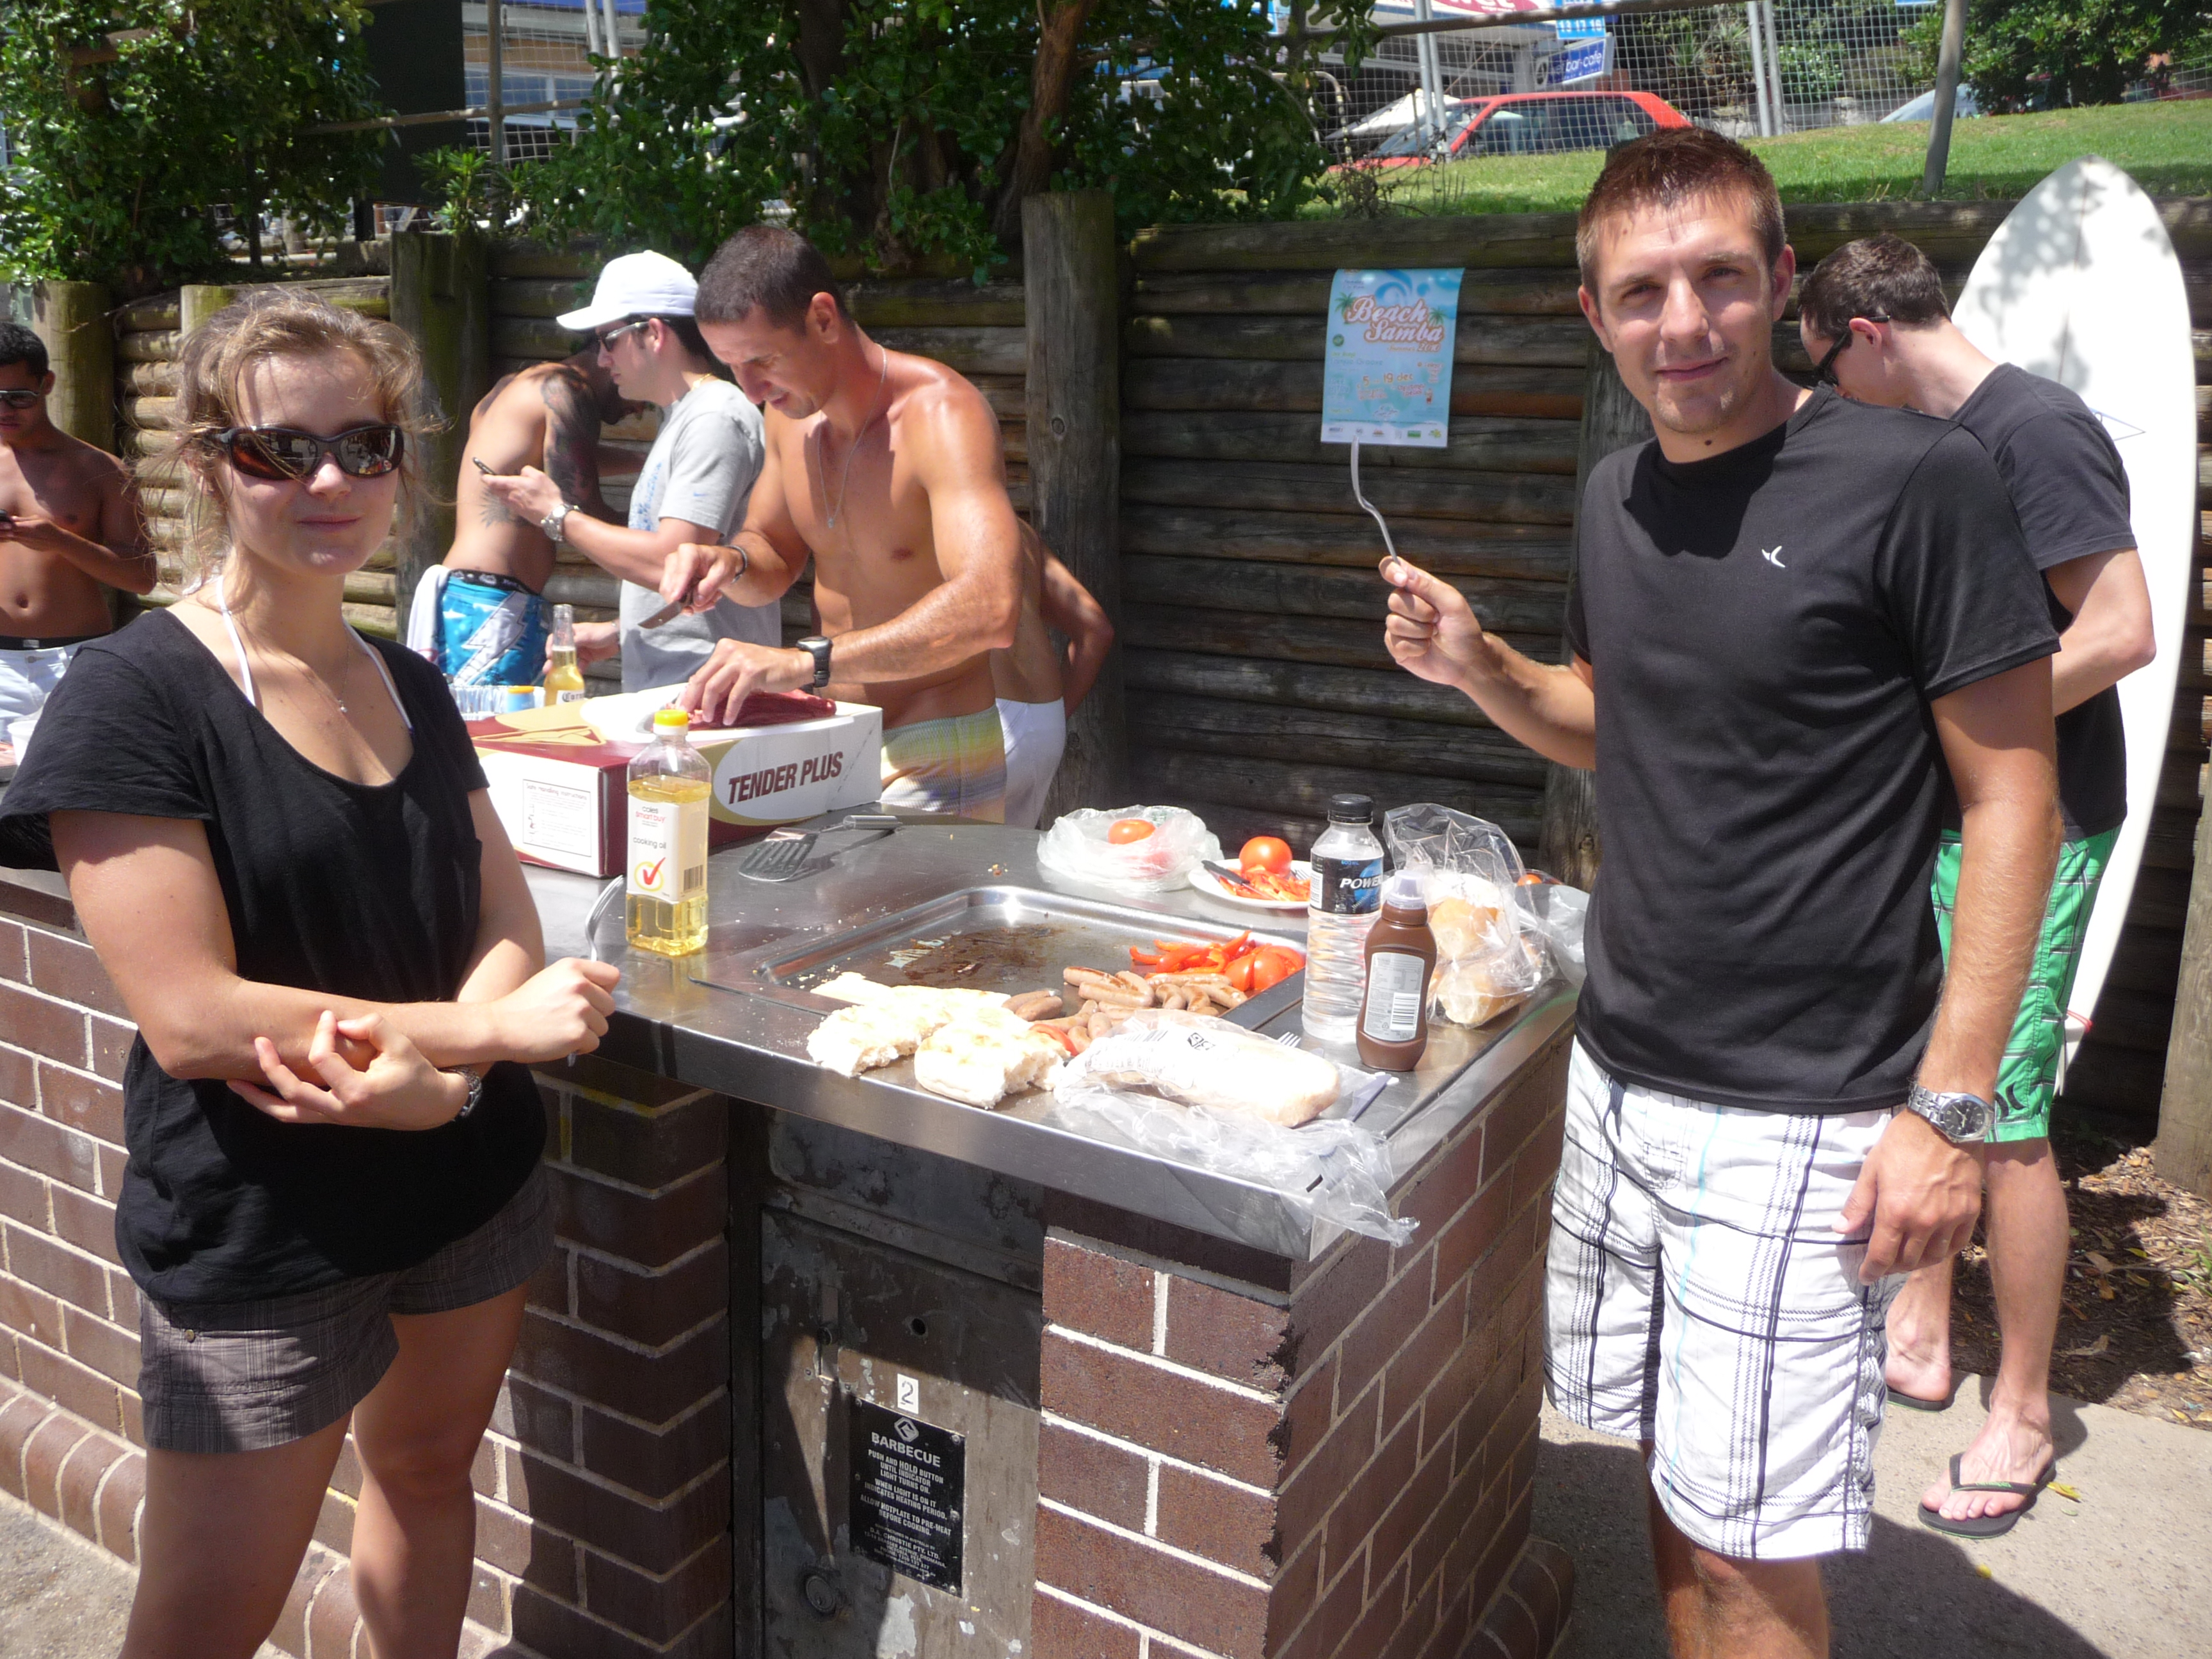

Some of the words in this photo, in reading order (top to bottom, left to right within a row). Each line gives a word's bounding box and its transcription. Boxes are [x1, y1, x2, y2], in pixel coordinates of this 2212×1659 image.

[1345, 296, 1428, 323] Beach
[1365, 319, 1444, 343] Samba
[1383, 372, 1394, 384] 19
[1397, 372, 1414, 382] dec
[728, 762, 797, 805] TENDER
[799, 751, 844, 787] PLUS
[636, 810, 653, 820] smart
[653, 814, 667, 824] buy
[633, 837, 658, 849] cooking
[659, 841, 667, 849] oil
[901, 1380, 914, 1405] 2
[871, 1432, 941, 1468] BARBECUE
[868, 1449, 885, 1461] PUSH
[885, 1455, 898, 1466] AND
[899, 1460, 918, 1473] HOLD
[919, 1468, 944, 1484] BUTTON
[880, 1462, 898, 1475] UNTIL
[899, 1469, 931, 1487] INDICATOR
[875, 1478, 892, 1491] WHEN
[894, 1485, 911, 1498] LIGHT
[912, 1493, 918, 1501] IS
[920, 1496, 929, 1505] ON
[930, 1500, 937, 1508] IT
[880, 1470, 898, 1482] LIGHT
[899, 1477, 918, 1490] TURNS
[920, 1484, 931, 1495] ON.
[865, 1481, 895, 1500] INDICATES
[896, 1495, 922, 1511] HEATING
[922, 1505, 947, 1520] PERIOD.
[860, 1494, 880, 1507] ALLOW
[881, 1502, 911, 1520] HOTPLATE
[911, 1514, 920, 1524] TO
[921, 1519, 952, 1536] PRE-HEAT
[879, 1509, 902, 1524] BEFORE
[903, 1519, 931, 1536] COOKING.
[870, 1527, 883, 1536] D.A.
[883, 1532, 911, 1549] CHRISTIE
[913, 1544, 926, 1555] PTY.
[927, 1550, 941, 1560] LTD.
